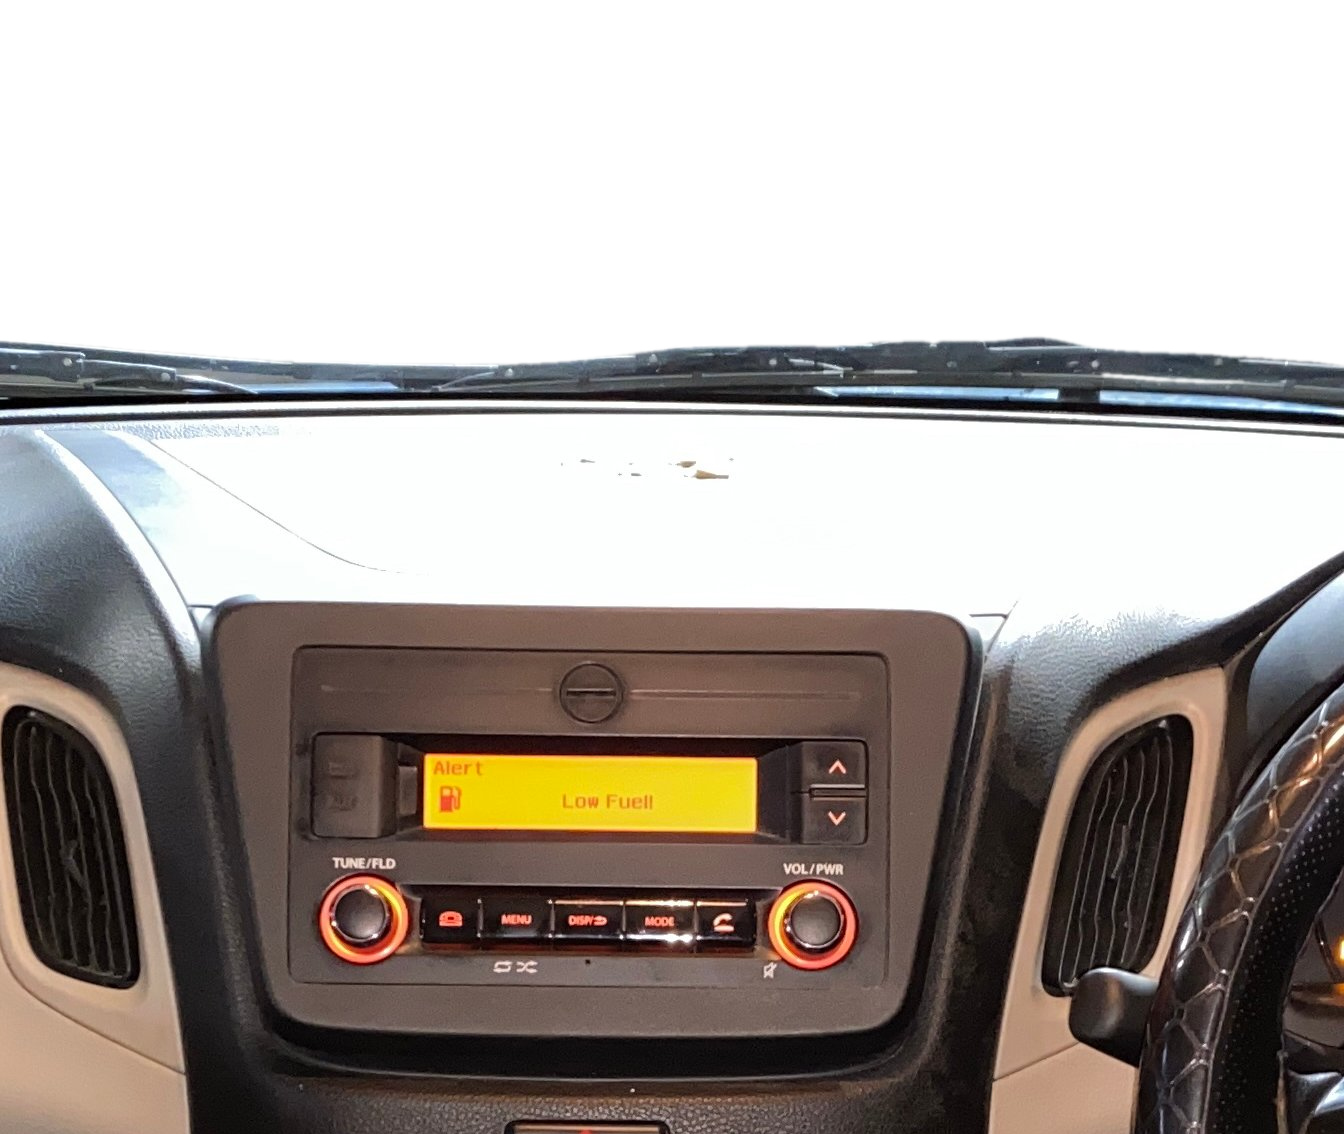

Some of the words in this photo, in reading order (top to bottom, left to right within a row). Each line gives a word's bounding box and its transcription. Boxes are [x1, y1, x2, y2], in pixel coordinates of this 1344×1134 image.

[433, 761, 483, 776] Alert
[562, 794, 599, 809] Low
[333, 857, 396, 870] TUNE/FLD
[501, 914, 532, 925] MENU
[645, 916, 675, 927] MODE
